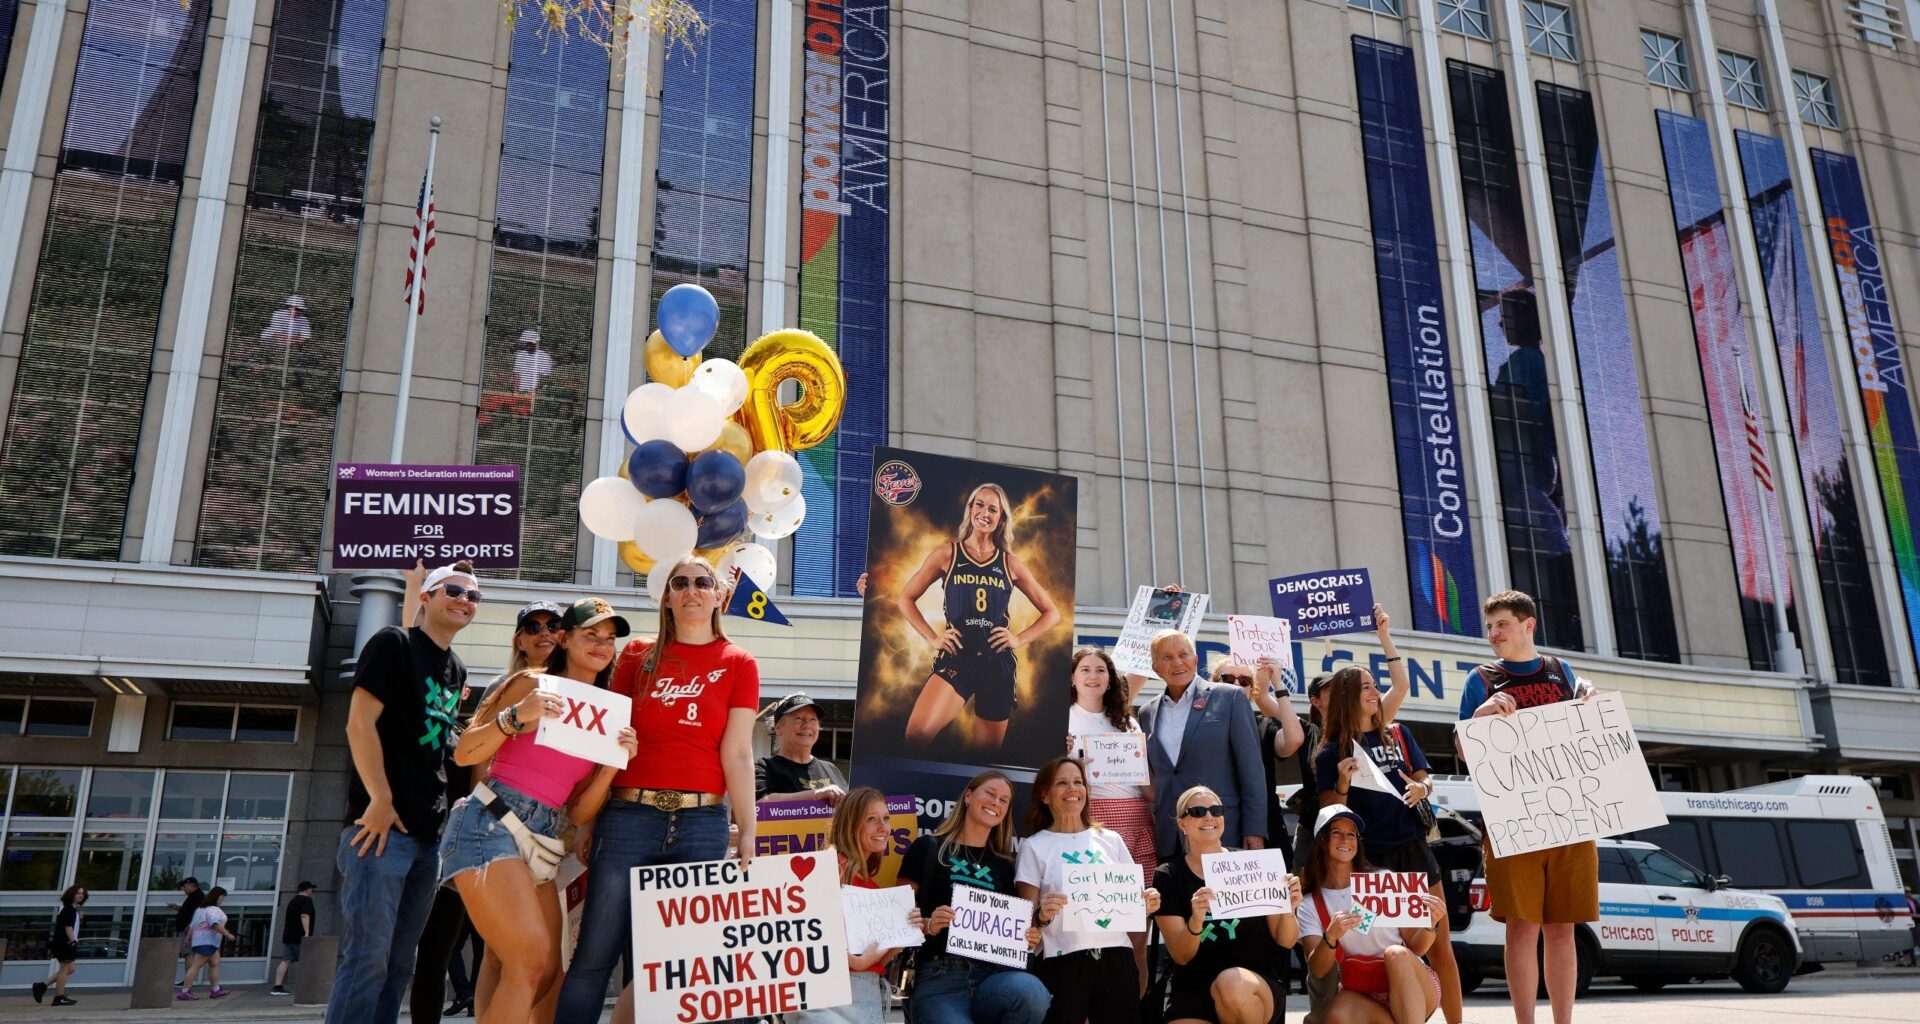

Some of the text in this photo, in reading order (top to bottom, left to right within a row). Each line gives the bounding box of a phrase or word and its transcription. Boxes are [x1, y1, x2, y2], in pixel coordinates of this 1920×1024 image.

[843, 6, 888, 213] AMERICA
[1850, 225, 1906, 388] AMERICA
[365, 468, 514, 479] Women's Declaration International
[344, 492, 513, 516] FEMINISTS
[414, 524, 444, 535] FOR
[340, 543, 514, 558] WOMEN'S SPORTS
[953, 574, 1005, 590] INDIANA
[1276, 574, 1363, 595] DEMOCRATS
[747, 591, 768, 619] 8
[976, 587, 987, 612] 8
[1307, 590, 1337, 604] FOR
[1297, 603, 1351, 620] SOPHIE
[1234, 620, 1288, 644] Protect
[1297, 619, 1354, 634] DI-AG.ORG
[651, 675, 706, 699] Indy
[562, 697, 609, 736] XX
[687, 702, 698, 721] 8
[1466, 699, 1619, 763] SOPHIE
[1093, 740, 1137, 752] Thank you
[1474, 730, 1635, 798] CUNNINGHAM
[1521, 776, 1601, 820] FOR
[1686, 797, 1789, 813] transitchicago.com
[769, 805, 809, 817] Women's
[1489, 801, 1624, 856] PRESIDENT
[639, 860, 752, 891] PROTECT
[1068, 870, 1137, 885] Girl Moms
[1212, 860, 1261, 874] GIRLS ARE
[1223, 871, 1280, 886] WORTHY OF
[1350, 872, 1429, 894] THANK
[657, 882, 807, 928] WOMEN'S
[969, 890, 1010, 910] FIND YOUR
[1071, 890, 1090, 903] FOR
[1216, 886, 1288, 908] PROTECTION
[1351, 894, 1401, 918] YOU
[722, 918, 823, 949] SPORTS
[952, 906, 1025, 941] COURAGE
[1601, 926, 1715, 943] CHICAGO POLICE
[949, 935, 973, 950] GIRLS
[974, 941, 988, 953] ARE
[990, 944, 1018, 959] WORTH
[642, 945, 830, 993] THANK YOU
[676, 981, 808, 1023] SOPHIE!
